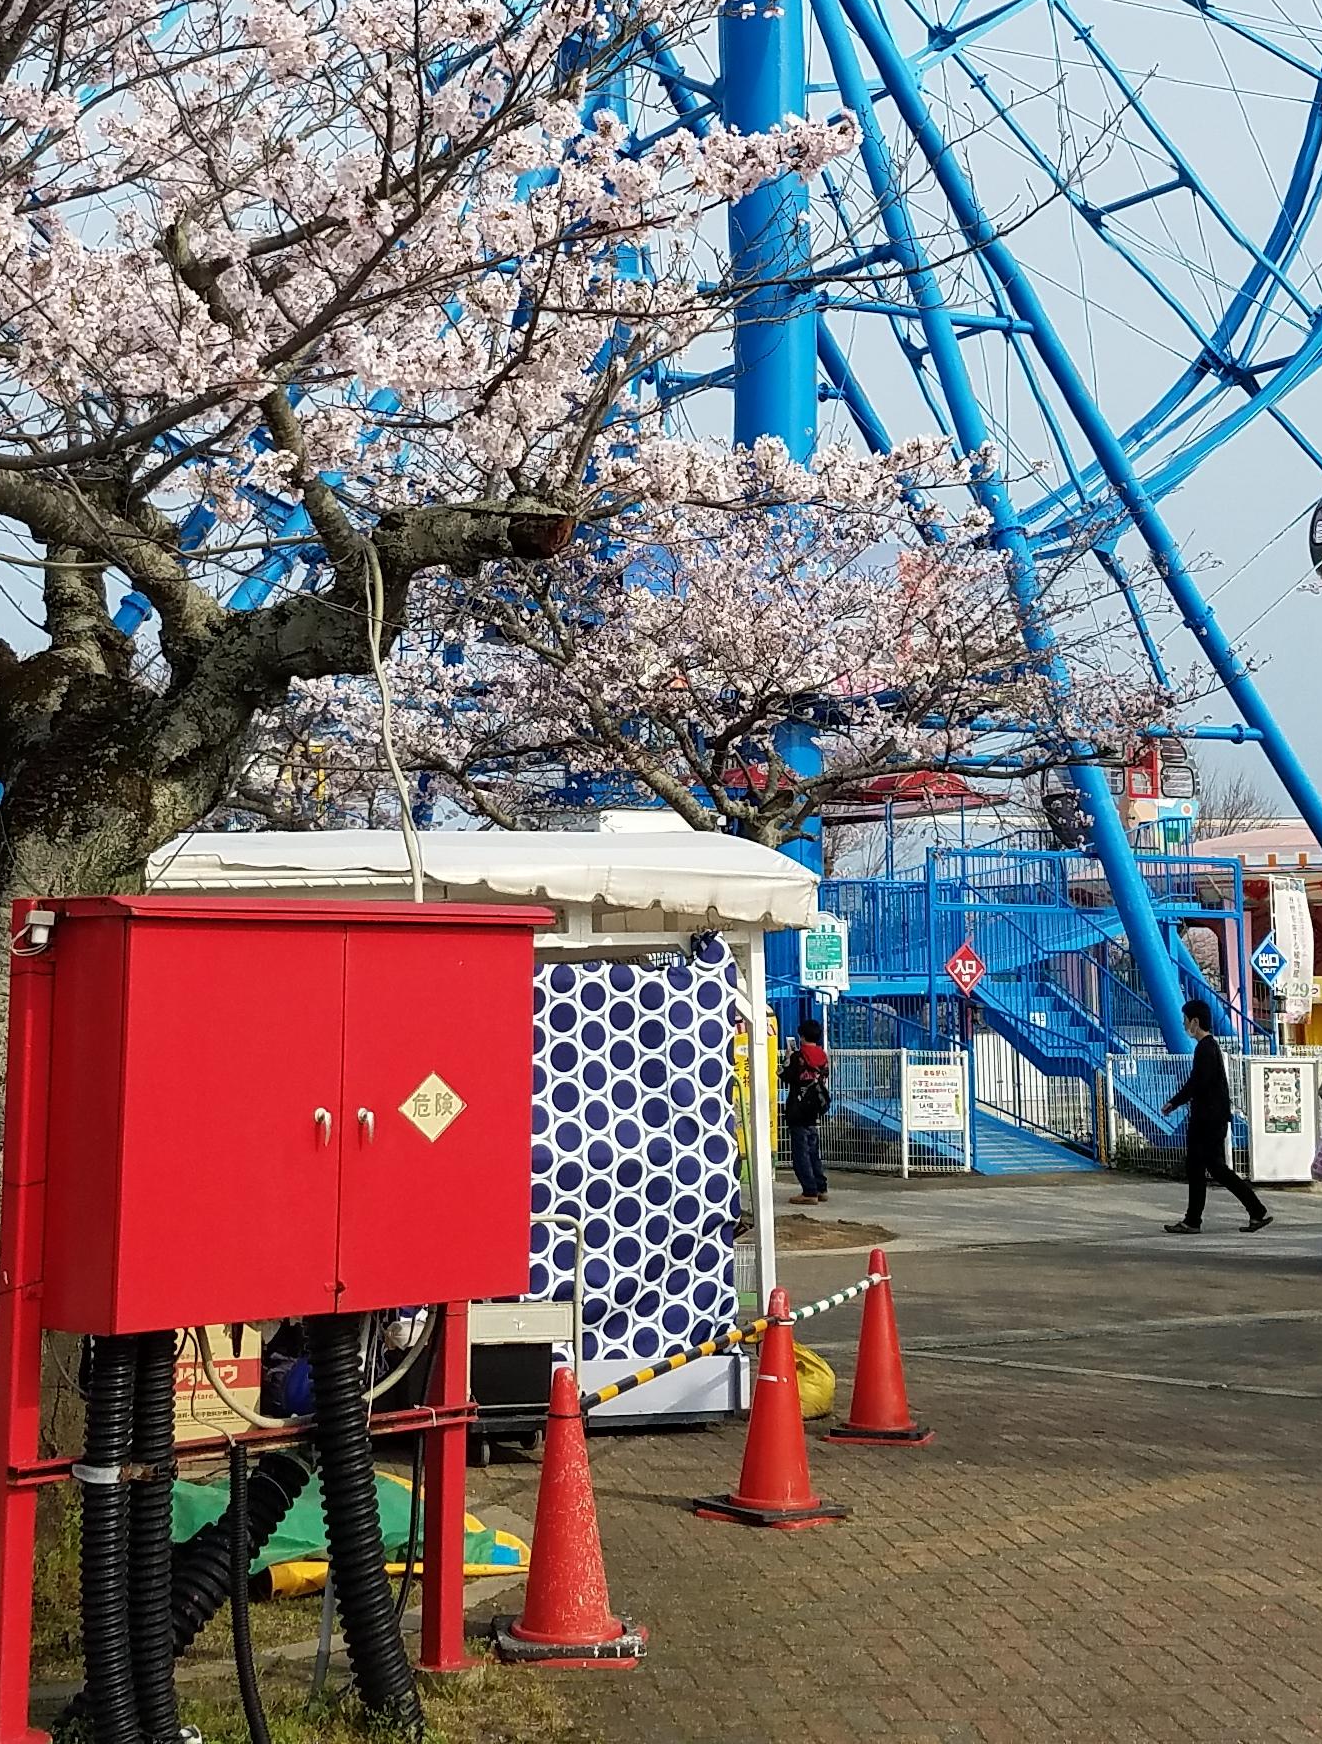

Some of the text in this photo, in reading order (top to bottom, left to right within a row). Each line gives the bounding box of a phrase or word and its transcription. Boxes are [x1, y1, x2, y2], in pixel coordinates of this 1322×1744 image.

[954, 959, 977, 974] 入口
[1259, 953, 1279, 967] 出口
[412, 1092, 453, 1117] 危険
